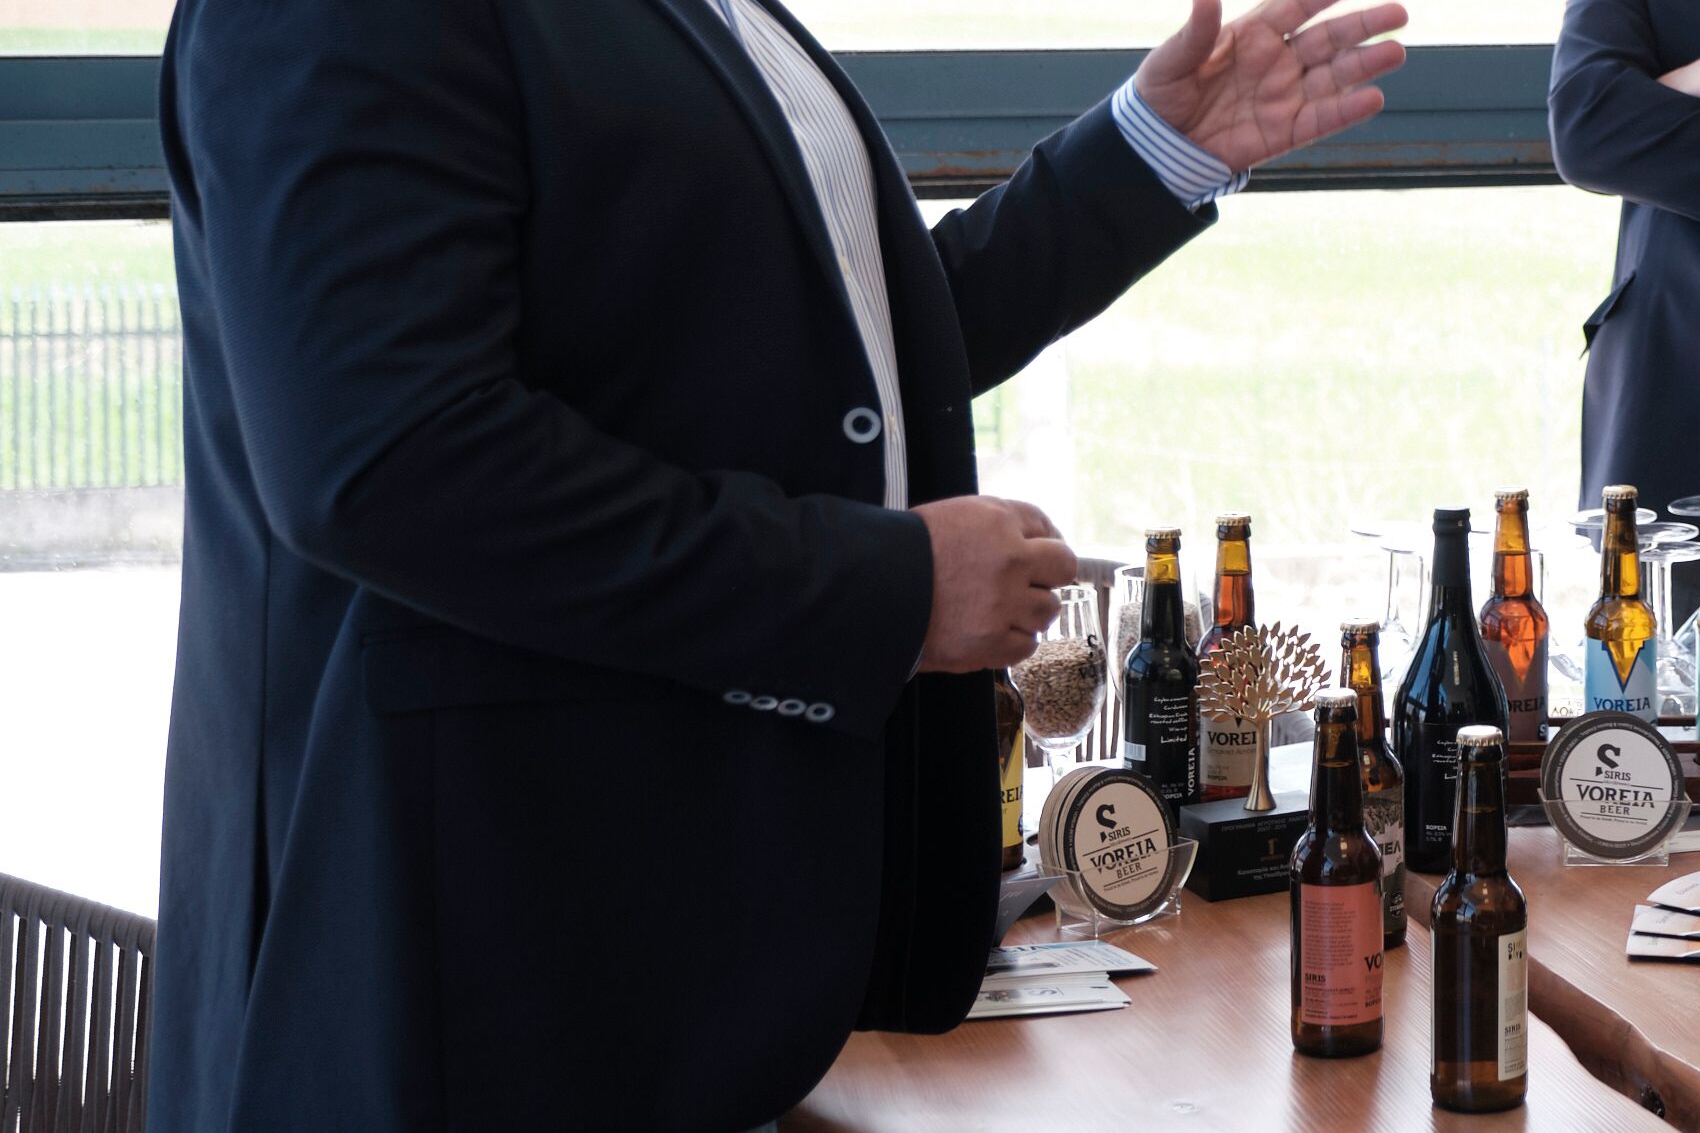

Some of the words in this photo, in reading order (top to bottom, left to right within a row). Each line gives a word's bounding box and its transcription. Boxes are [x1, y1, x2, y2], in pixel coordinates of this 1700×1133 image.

[1593, 697, 1651, 712] VOREIA
[1207, 730, 1257, 746] VOREI
[1187, 747, 1196, 797] VOREIA
[1604, 770, 1631, 781] SIRIS
[1000, 786, 1024, 804] REI
[1576, 783, 1655, 809] VOREIA
[1600, 804, 1631, 816] BEER
[1107, 826, 1131, 842] SIRIS
[1090, 837, 1157, 874] VOREIA
[1116, 862, 1142, 879] BEER
[1305, 973, 1326, 983] SIRIS
